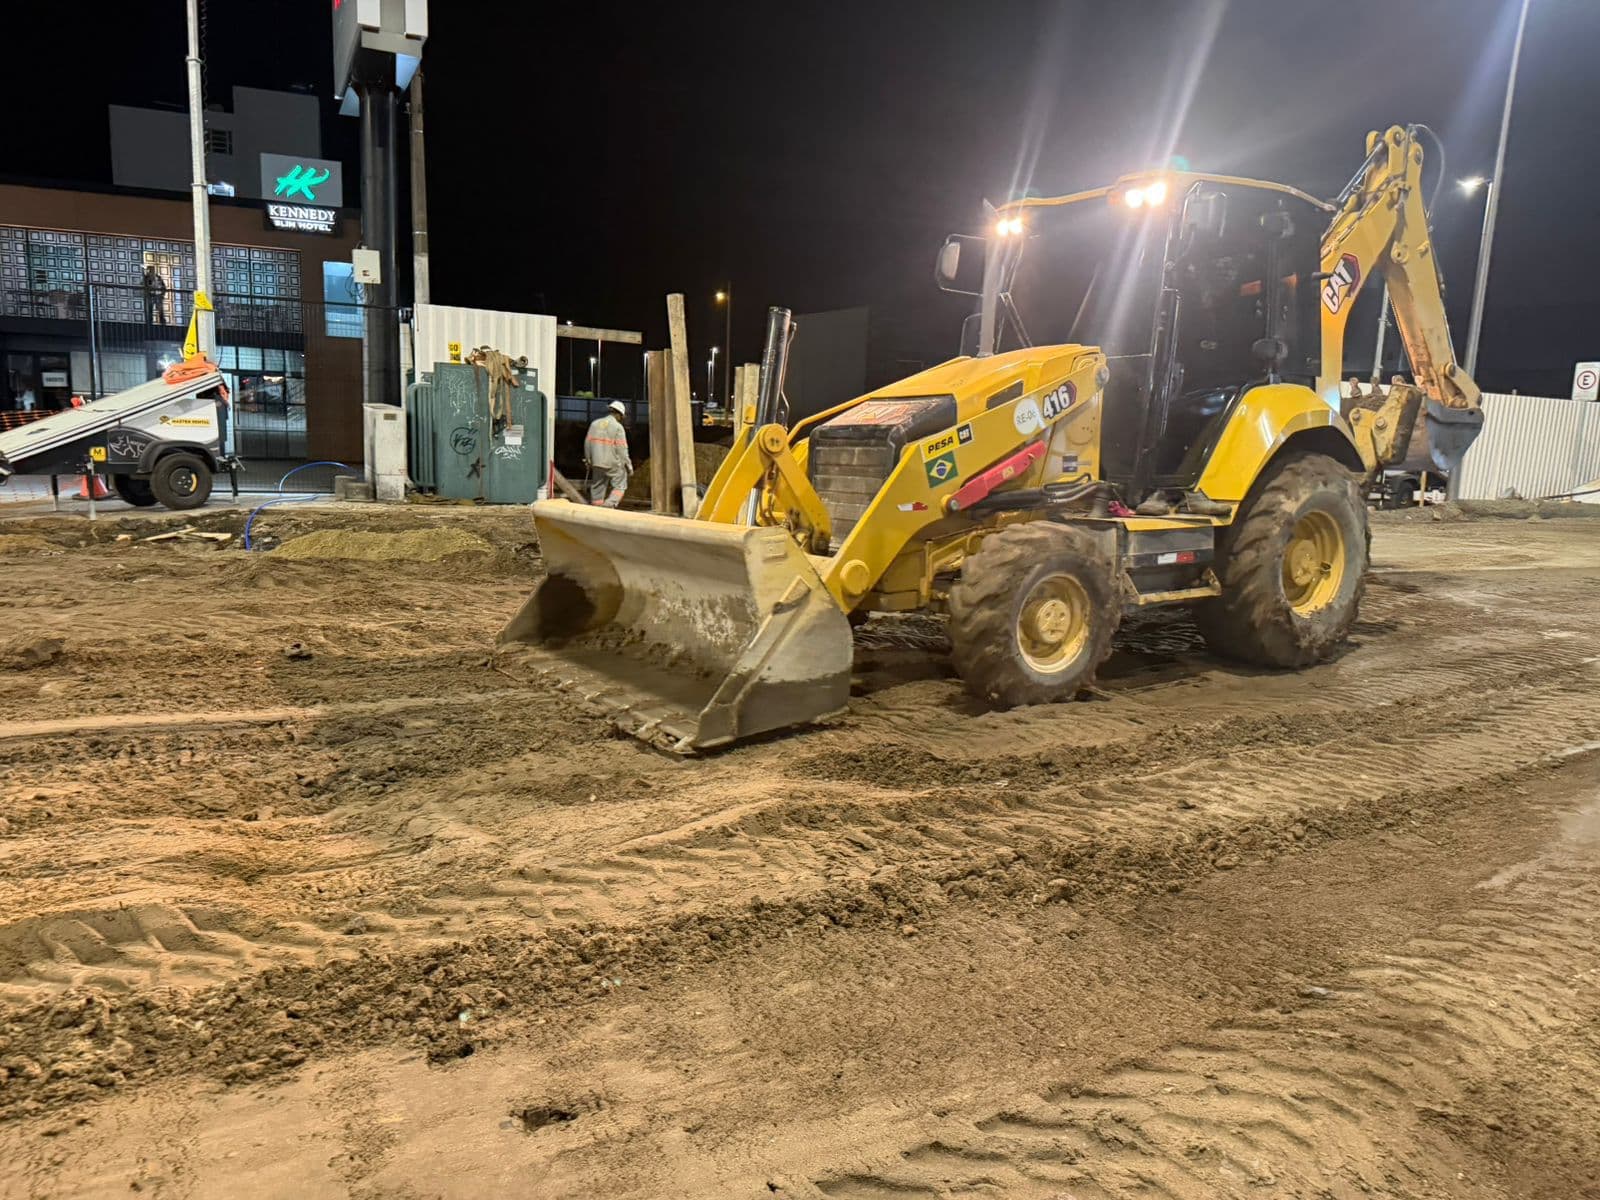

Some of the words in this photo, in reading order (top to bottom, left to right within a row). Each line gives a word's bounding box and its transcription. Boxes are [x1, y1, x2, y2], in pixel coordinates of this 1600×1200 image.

[268, 204, 336, 221] KENNEDY
[298, 221, 332, 231] HOTEL
[1322, 258, 1354, 313] CAT
[1582, 374, 1591, 386] E
[1043, 384, 1070, 419] 416
[927, 436, 954, 455] PESA
